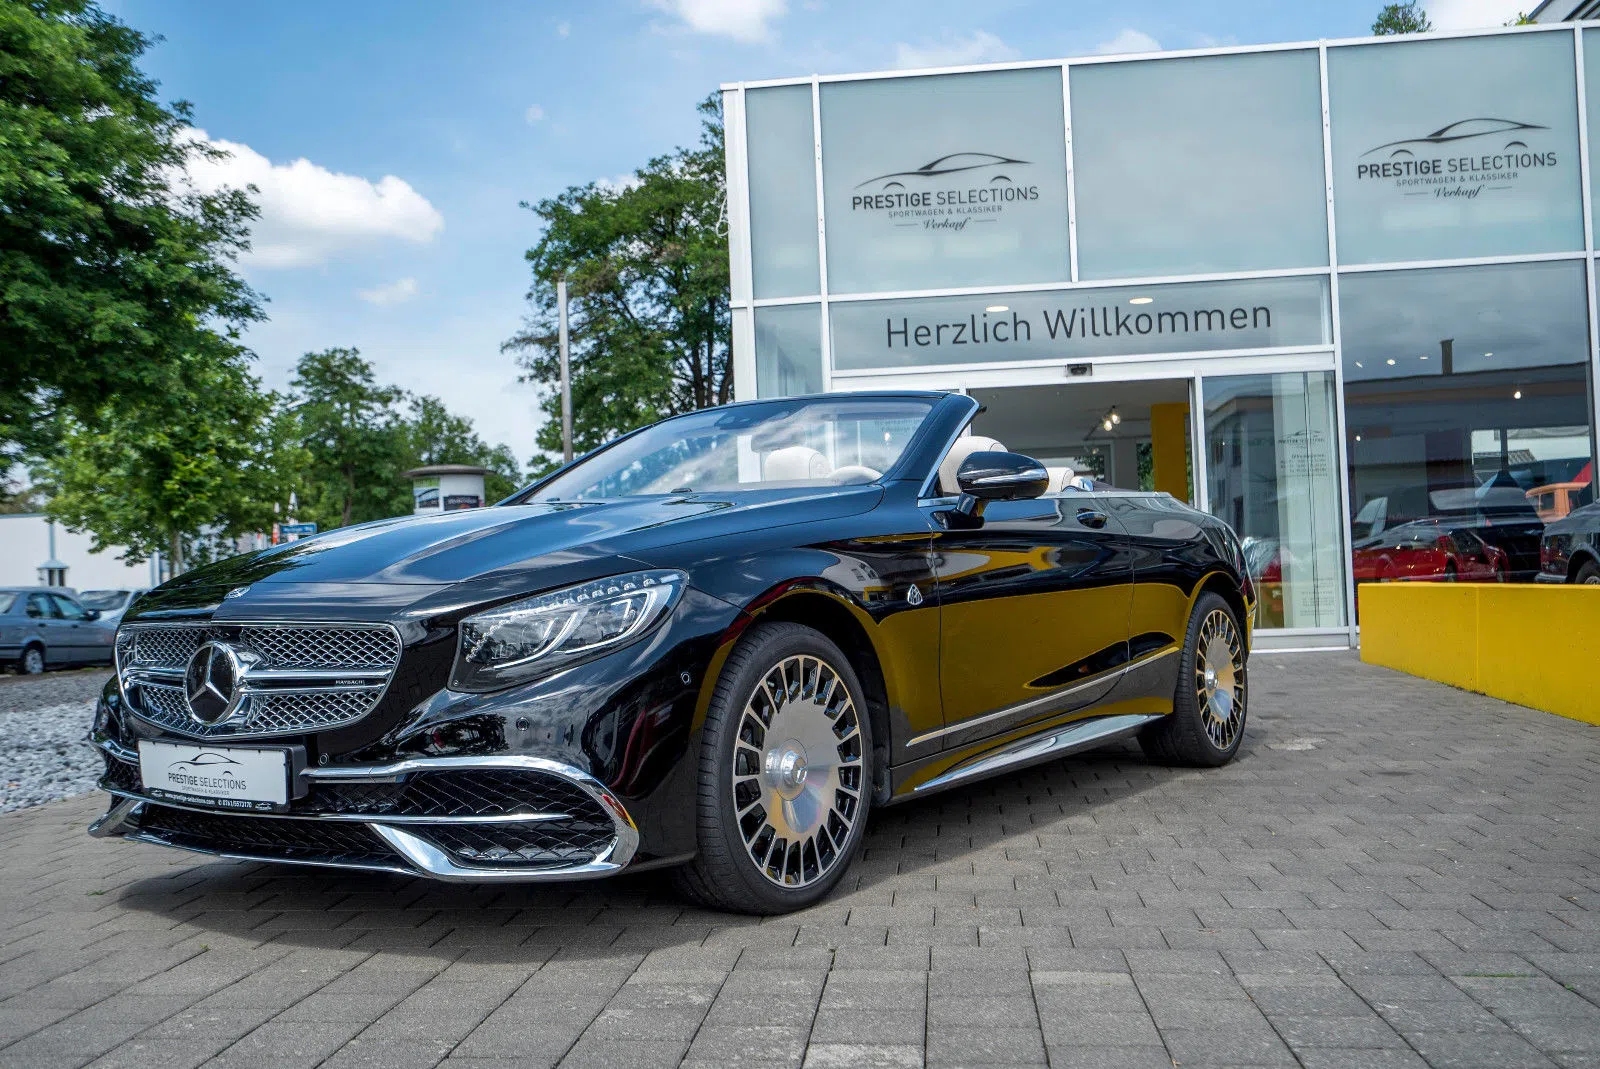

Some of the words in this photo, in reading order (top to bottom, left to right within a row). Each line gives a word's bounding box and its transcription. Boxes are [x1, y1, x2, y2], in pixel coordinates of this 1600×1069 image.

[1357, 159, 1443, 179] PRESTIGE
[1447, 152, 1557, 173] SELECTIONS
[1396, 176, 1456, 187] SPORTWAGEN
[1459, 174, 1466, 183] &
[1469, 172, 1519, 182] KLASSIKER
[852, 192, 931, 211] PRESTIGE
[936, 186, 1039, 206] SELECTIONS
[1433, 184, 1485, 199] Verkauf
[888, 208, 945, 218] SPORTWAGEN
[947, 207, 953, 215] &
[956, 205, 1003, 214] KLASSIKER
[923, 216, 971, 231] Verkauf
[886, 312, 1031, 348] Herzlich
[1043, 305, 1272, 340] Willkommen
[168, 772, 198, 786] PRESTIGE
[199, 777, 247, 790] SELECTIONS
